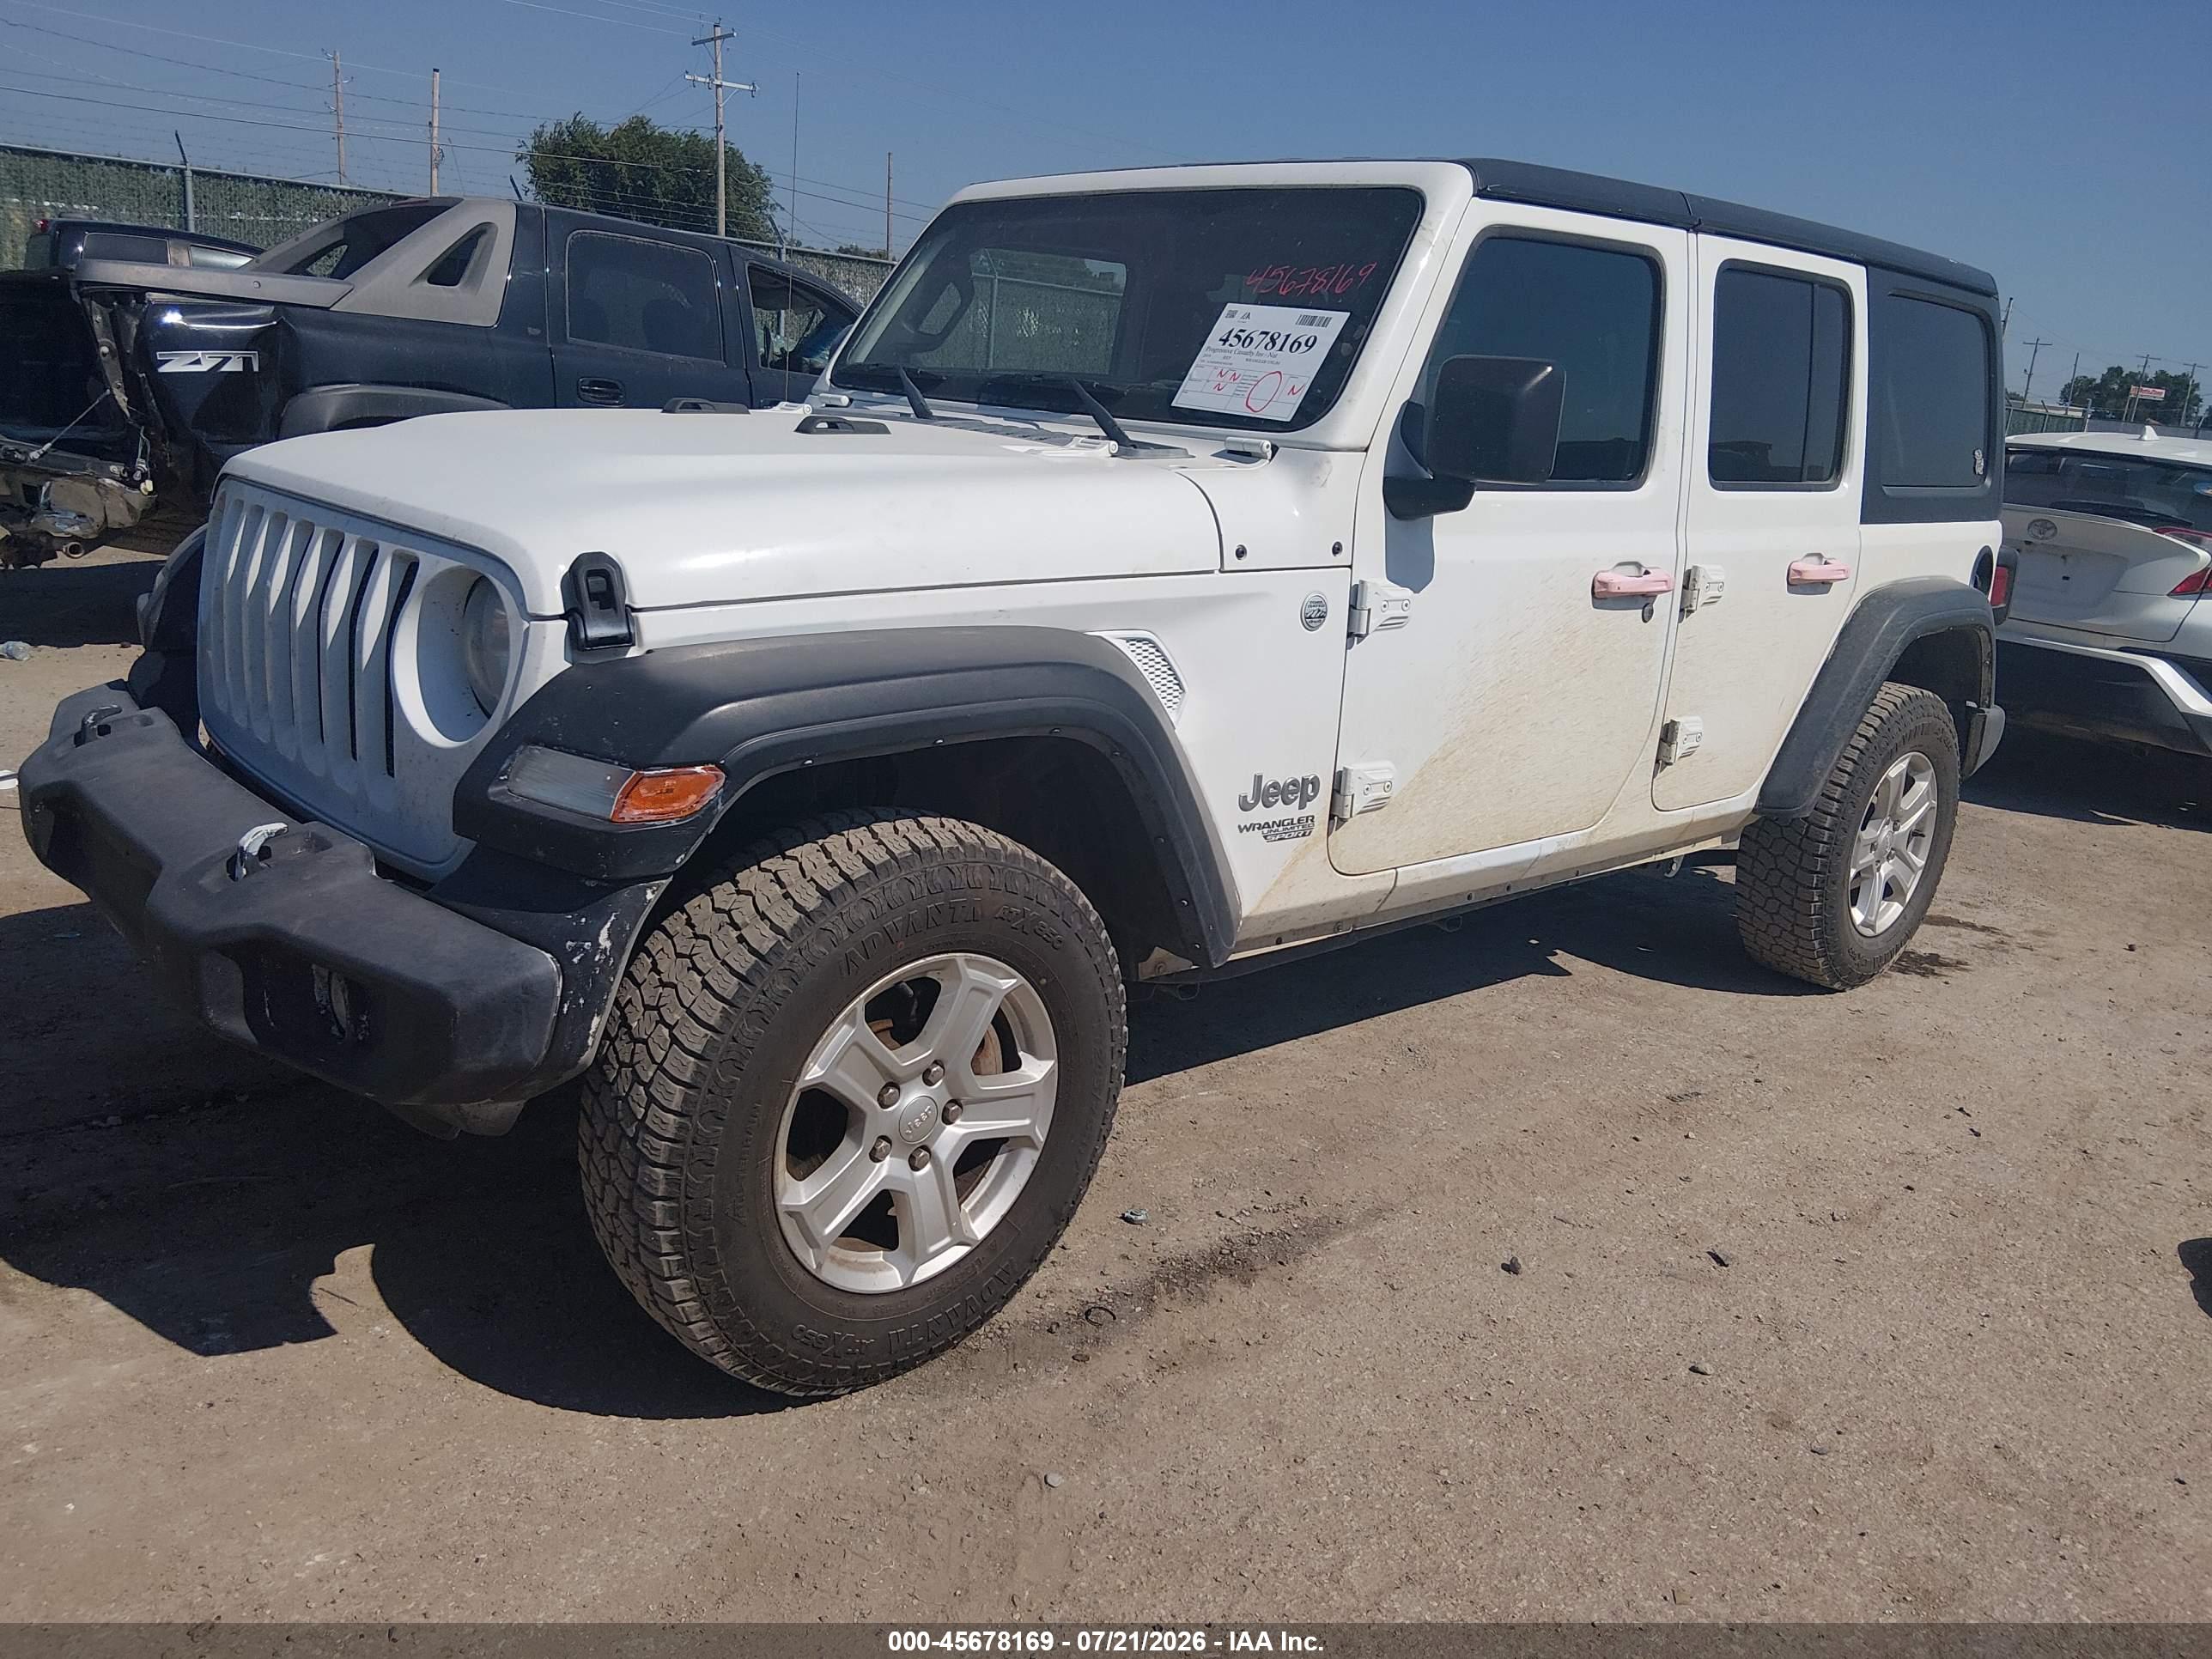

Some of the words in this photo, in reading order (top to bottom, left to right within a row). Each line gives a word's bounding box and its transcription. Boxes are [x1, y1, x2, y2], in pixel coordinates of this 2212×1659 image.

[1246, 261, 1377, 296] 45678169
[1218, 327, 1318, 355] 45678169
[156, 350, 258, 373] Z71
[1238, 772, 1321, 811] Jeep
[1237, 815, 1315, 833] WRANGLER
[1262, 823, 1315, 835] UNLIMITED
[1266, 830, 1313, 842] SPORT
[904, 1105, 933, 1133] Jeep
